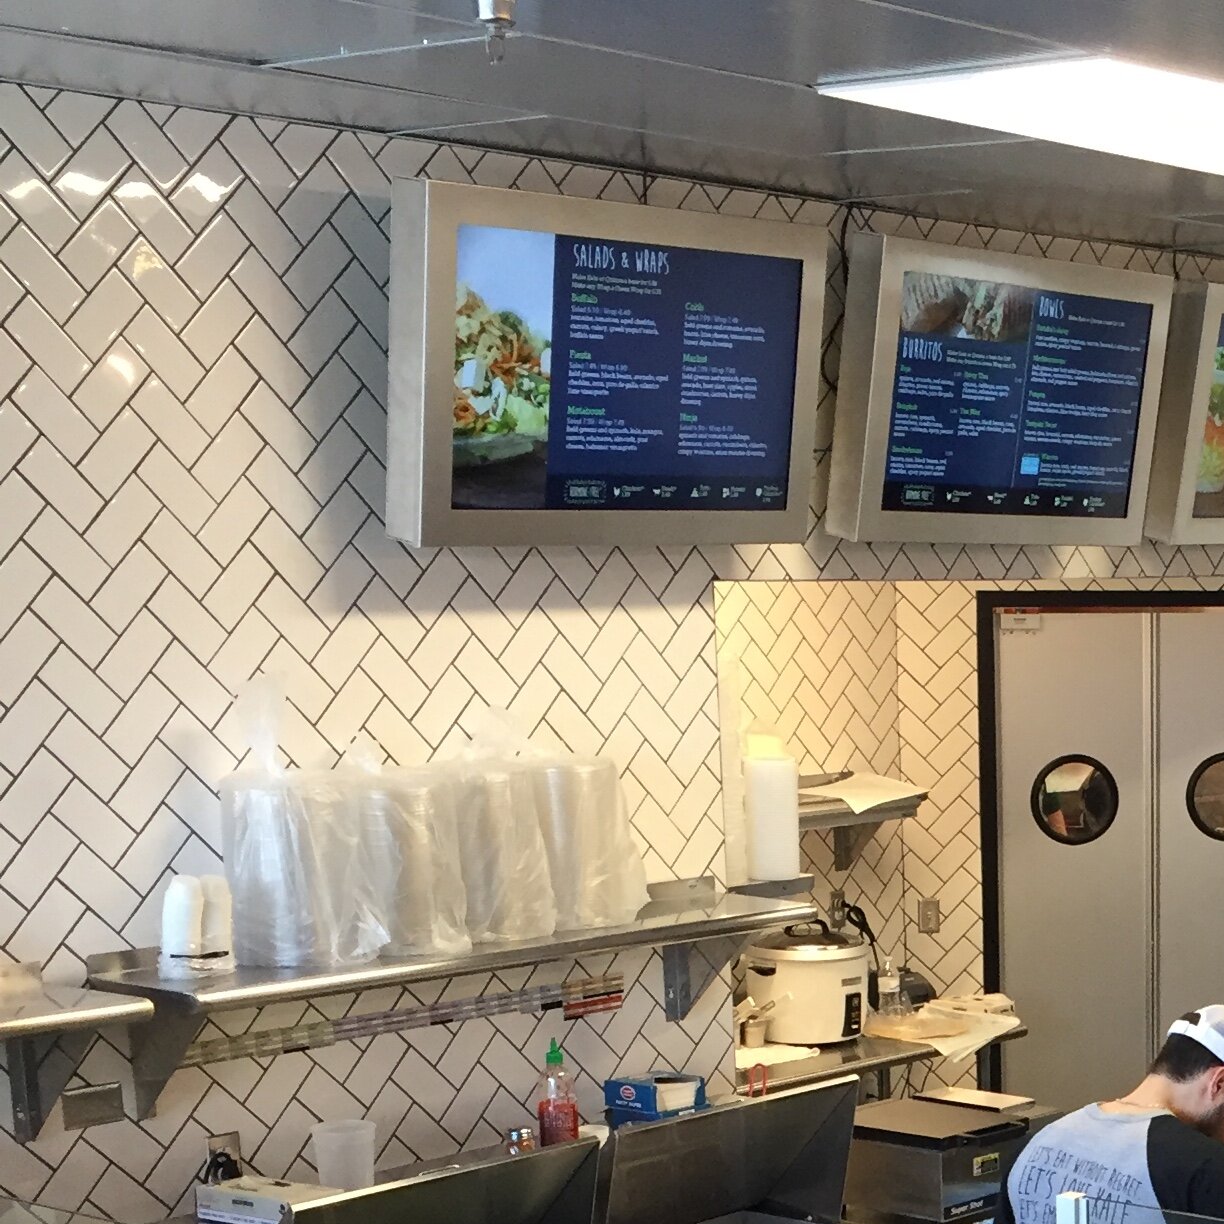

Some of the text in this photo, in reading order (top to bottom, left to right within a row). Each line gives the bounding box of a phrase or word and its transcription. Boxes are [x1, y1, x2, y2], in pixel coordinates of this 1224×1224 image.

[573, 243, 670, 275] SALADS & WRAPS
[1039, 296, 1064, 320] BOWLS
[902, 336, 943, 362] BURRITOS
[1054, 1149, 1073, 1169] EAT
[1018, 1164, 1057, 1199] LET'S
